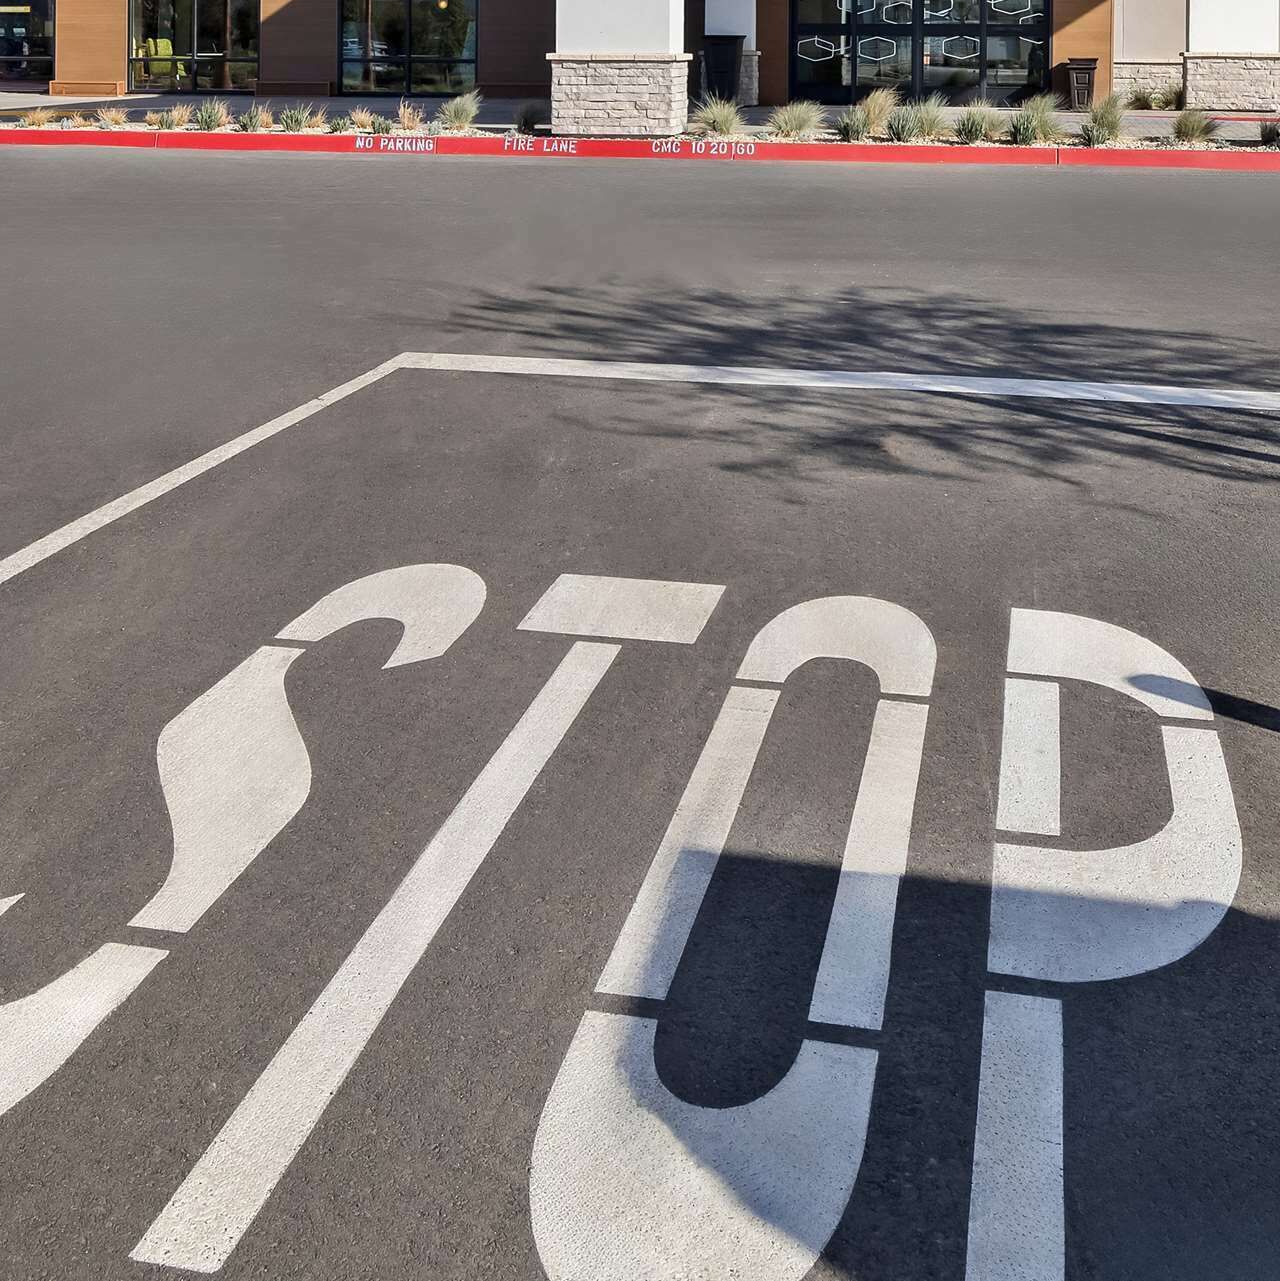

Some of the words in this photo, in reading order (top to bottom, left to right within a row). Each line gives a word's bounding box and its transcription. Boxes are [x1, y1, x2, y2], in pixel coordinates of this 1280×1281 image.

[356, 137, 373, 149] NO
[380, 138, 434, 151] PARKING
[504, 138, 534, 151] FIRE
[543, 140, 577, 153] LANE
[652, 141, 680, 153] CMC
[691, 142, 705, 154] 10
[710, 142, 728, 154] 20
